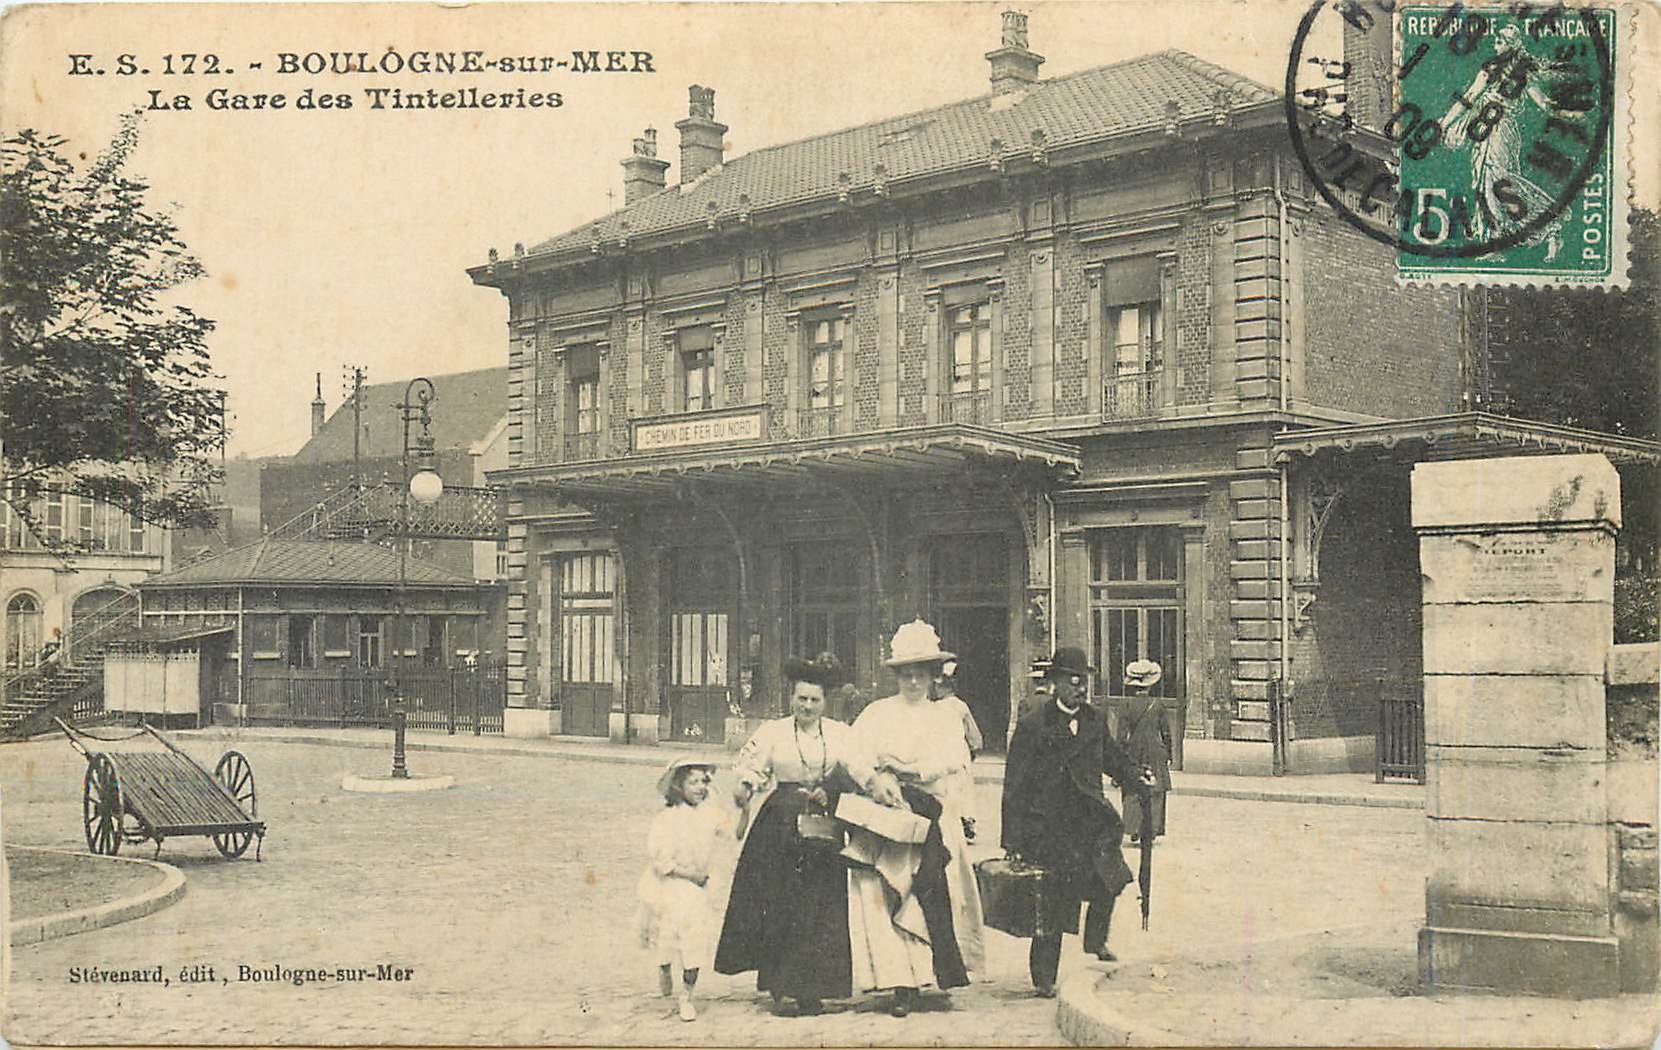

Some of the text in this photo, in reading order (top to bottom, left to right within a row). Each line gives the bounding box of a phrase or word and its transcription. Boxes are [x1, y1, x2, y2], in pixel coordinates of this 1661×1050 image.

[1413, 188, 1450, 245] 5
[1583, 173, 1603, 259] POSTES
[645, 419, 751, 445] CHEMIN DE FER DU NORD
